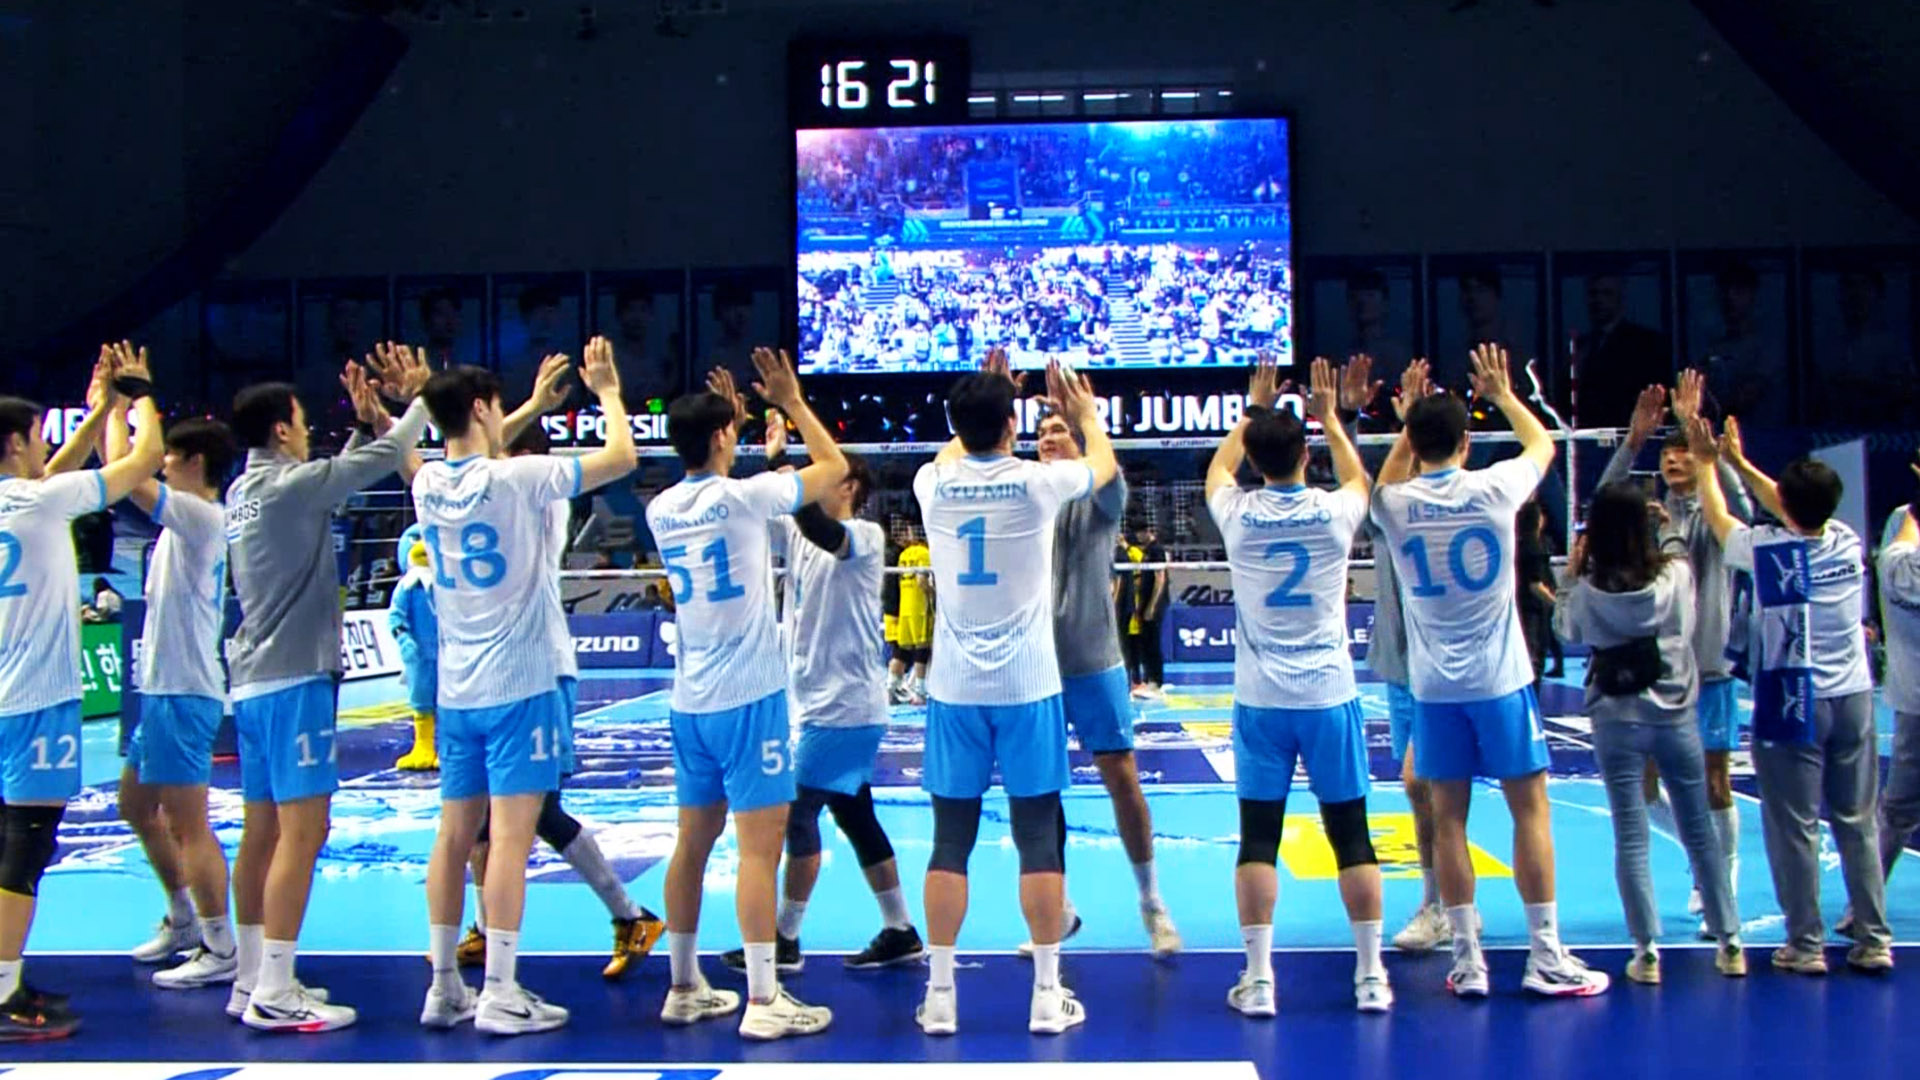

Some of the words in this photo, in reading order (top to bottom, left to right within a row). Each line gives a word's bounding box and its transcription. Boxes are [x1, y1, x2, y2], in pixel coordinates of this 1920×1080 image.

[821, 60, 868, 108] 16
[888, 59, 935, 107] 21
[424, 522, 507, 590] 18
[661, 535, 746, 605] 51
[957, 516, 998, 586] 1
[1263, 541, 1313, 607] 2
[1401, 527, 1502, 598] 10
[571, 636, 640, 652] IZUNO
[31, 735, 77, 769] 12
